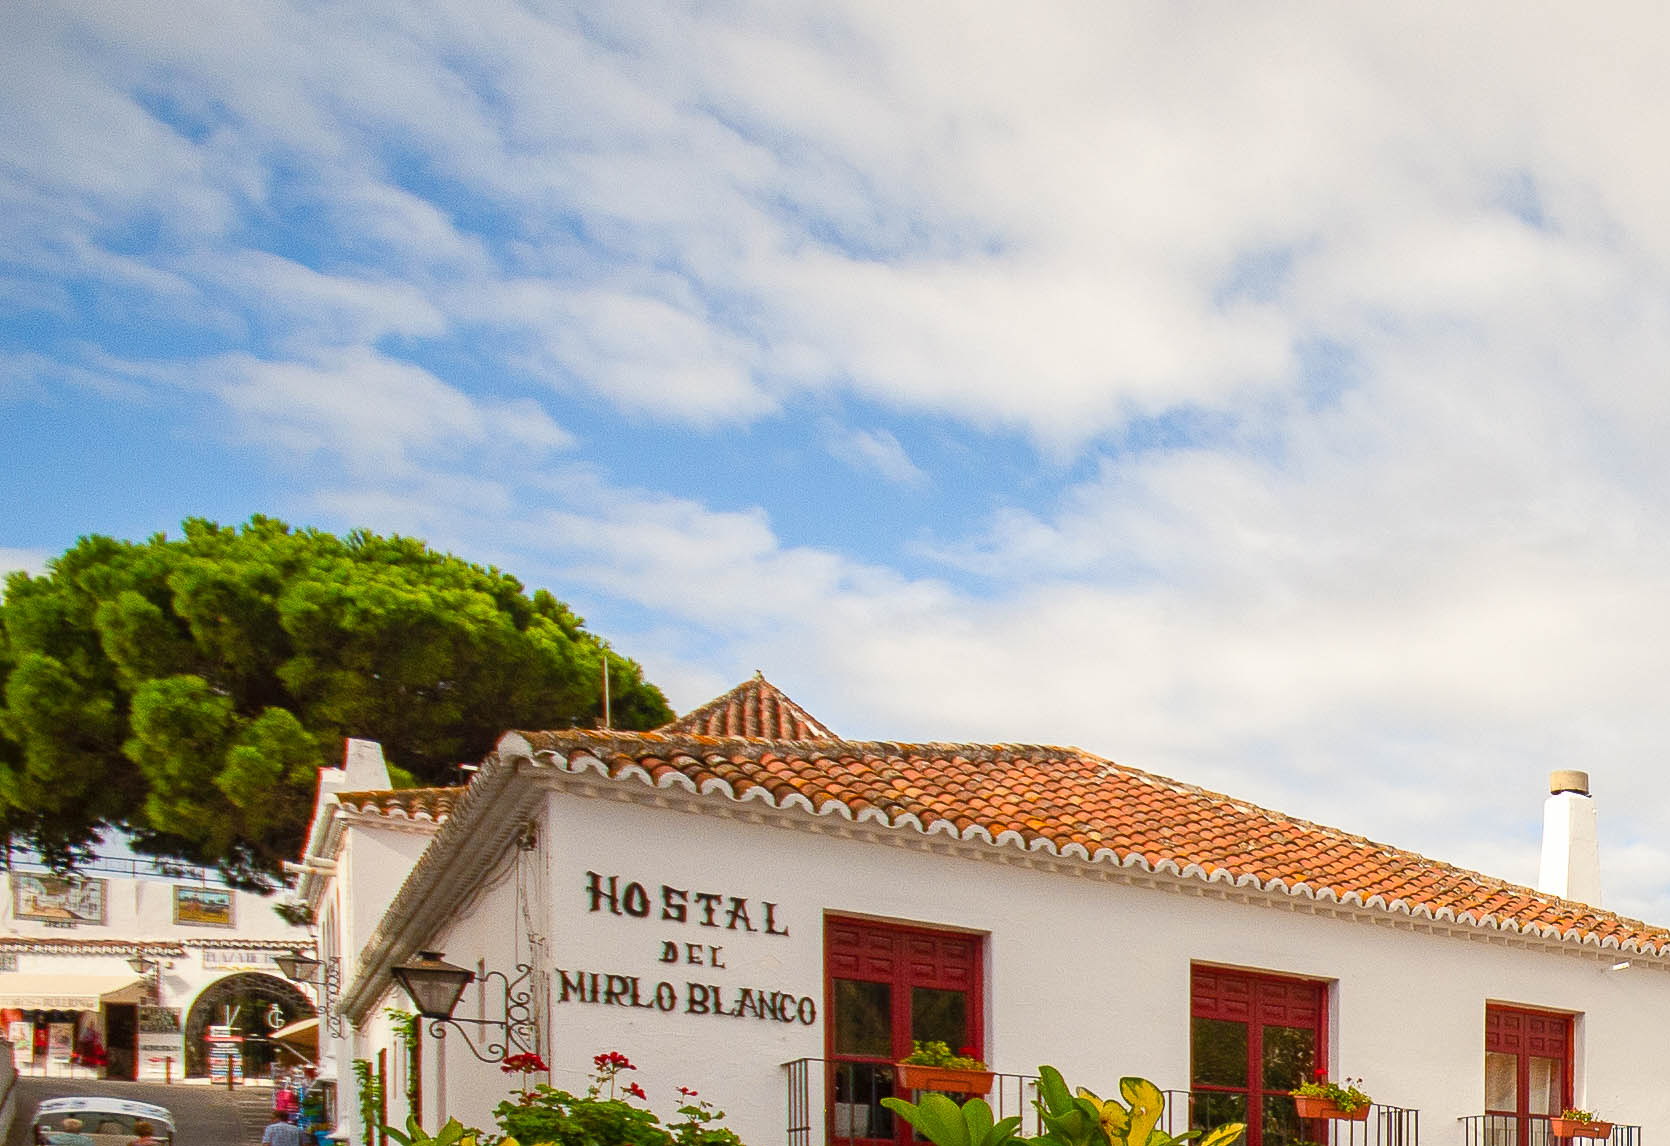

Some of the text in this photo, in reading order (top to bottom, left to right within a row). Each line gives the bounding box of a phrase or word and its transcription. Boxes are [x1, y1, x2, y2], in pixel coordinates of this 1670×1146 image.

[586, 870, 790, 937] HOSTAL
[658, 940, 726, 969] DEL
[555, 968, 817, 1026] MIRLO BLANCO
